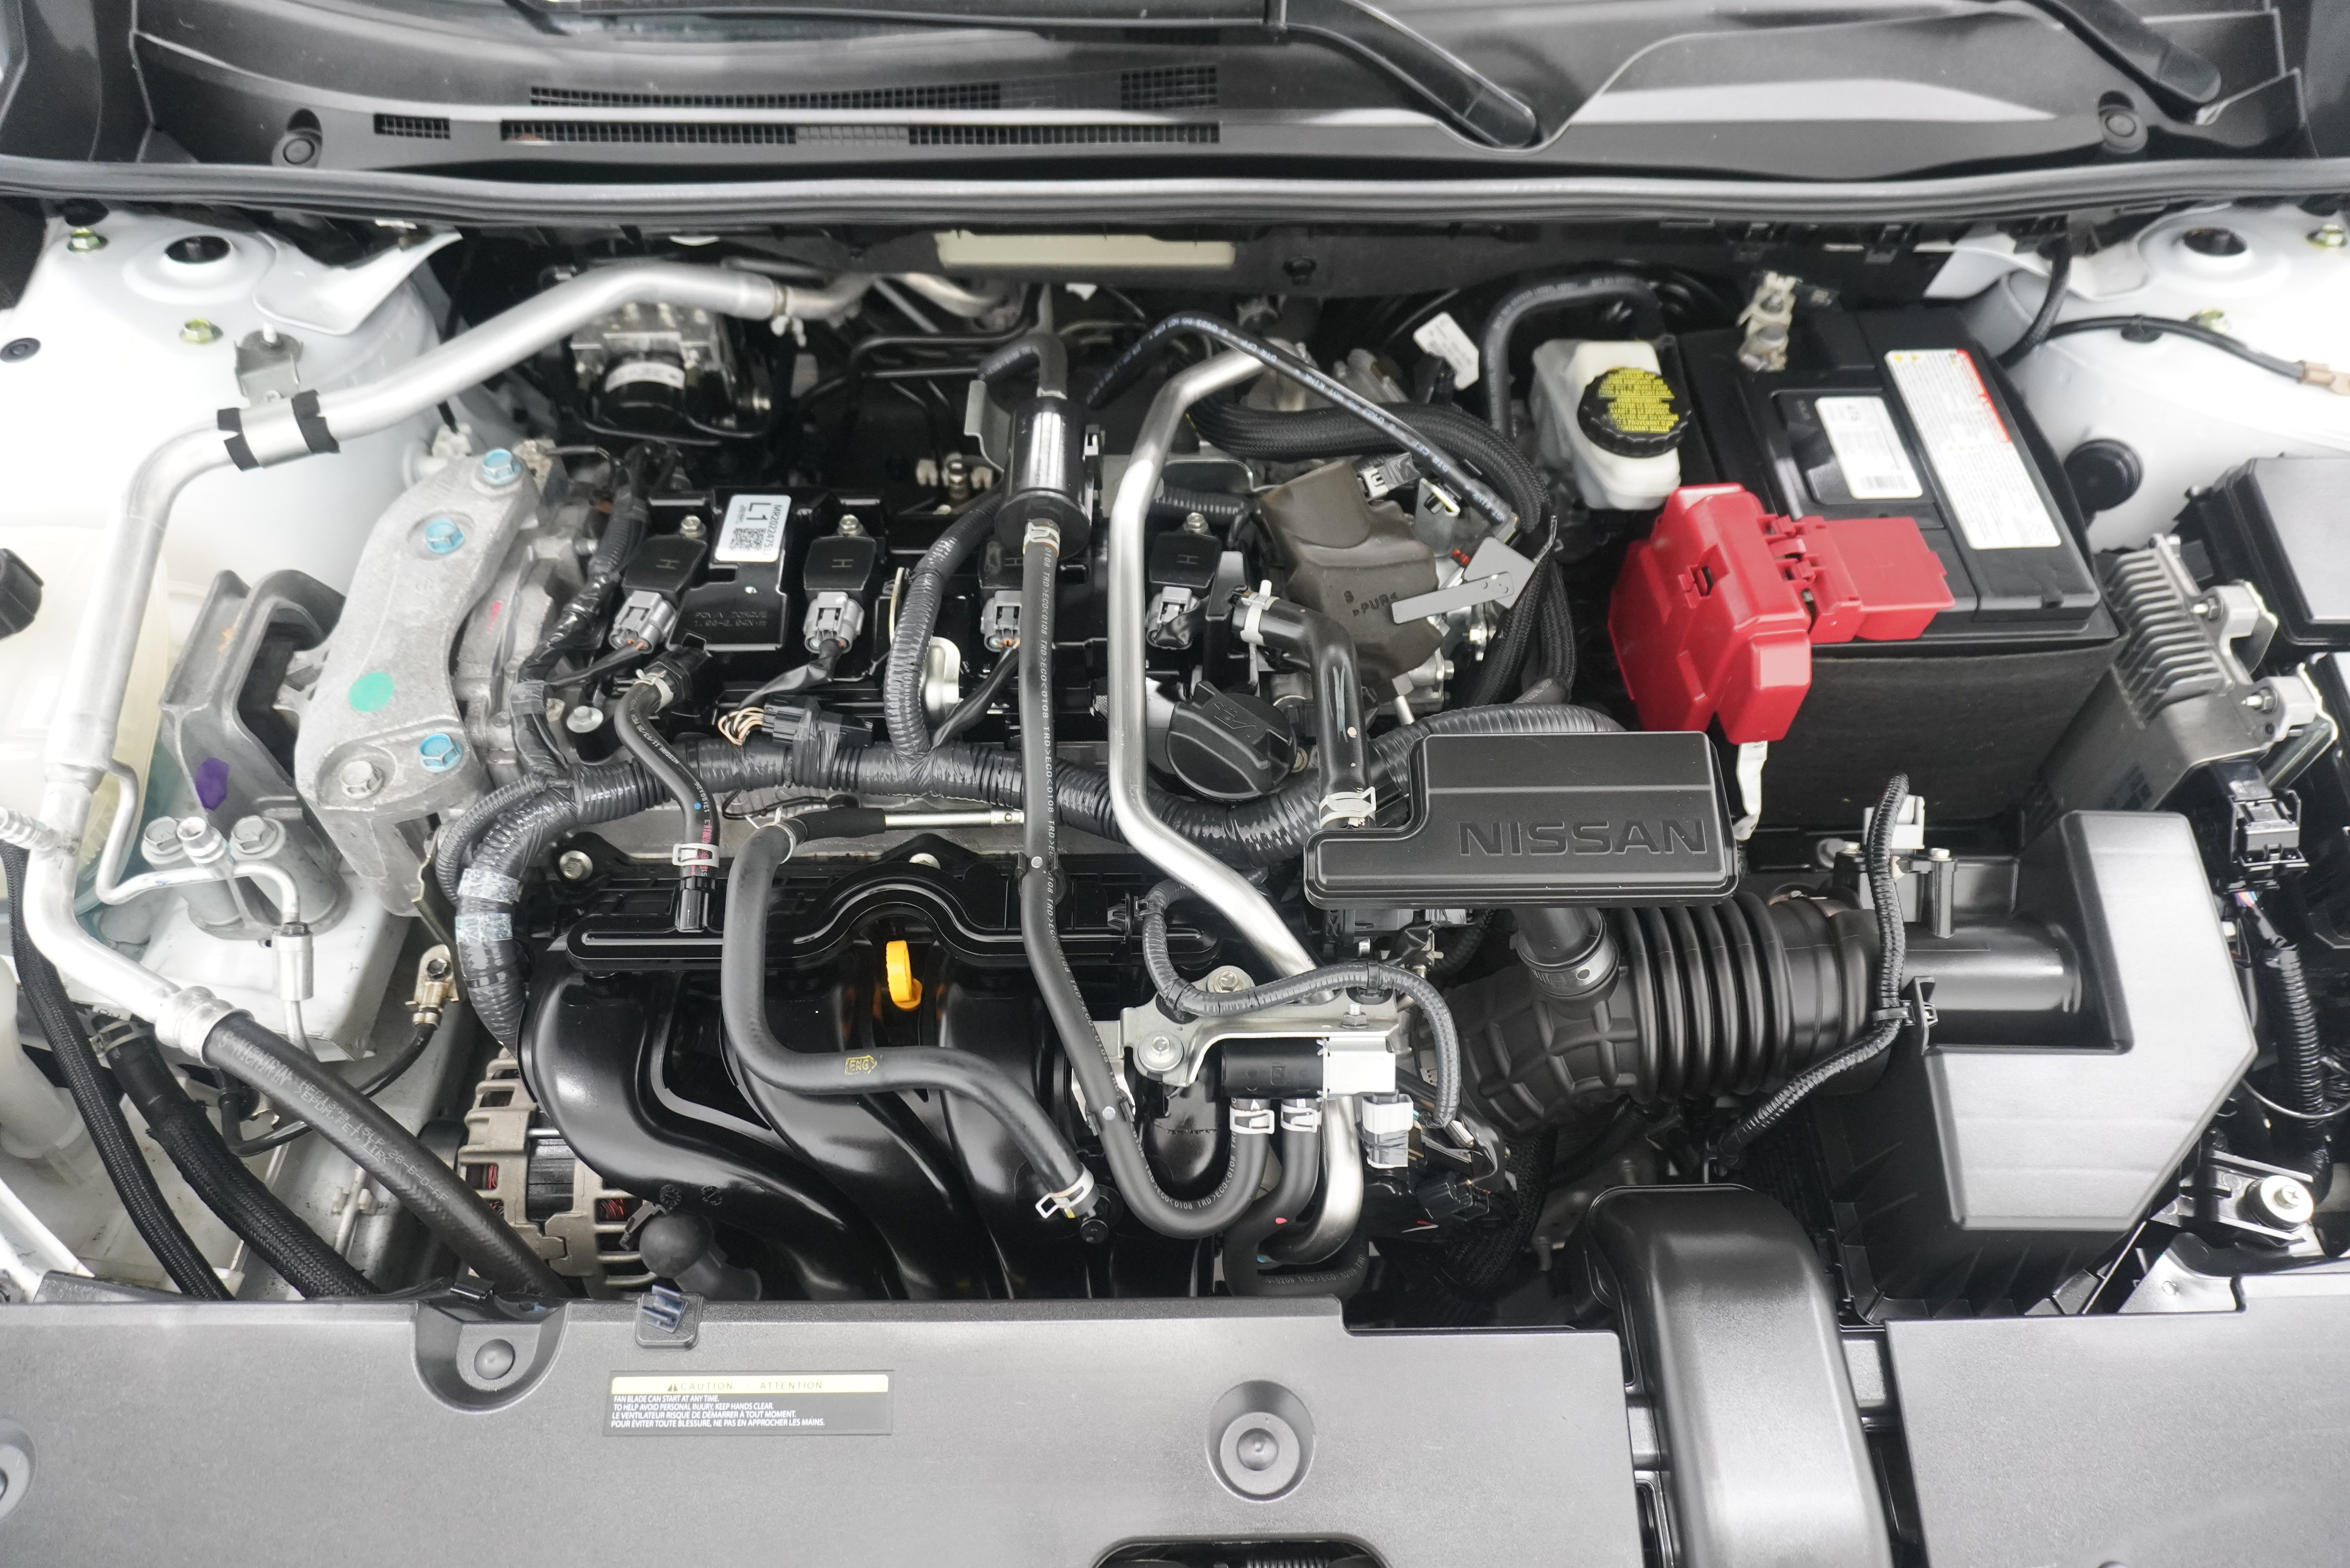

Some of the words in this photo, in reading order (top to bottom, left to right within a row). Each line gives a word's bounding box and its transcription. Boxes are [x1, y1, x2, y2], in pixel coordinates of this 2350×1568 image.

[746, 503, 772, 520] L1
[659, 747, 680, 764] NISSAN
[1457, 819, 1708, 857] NISSAN
[849, 1059, 869, 1071] ENG
[681, 1382, 733, 1390] CAUTION
[760, 1382, 823, 1390] ATTENTION
[693, 1403, 714, 1412] INJURY,
[621, 1411, 665, 1419] VENTILATEUR
[666, 1411, 690, 1419] RISQUE
[702, 1410, 739, 1418] DÉMARRER
[740, 1410, 745, 1418] À
[632, 1419, 654, 1427] ÉVITER
[678, 1419, 712, 1428] BLESSURE,
[748, 1418, 788, 1427] APPROCHER
[802, 1417, 825, 1426] MAINS.
